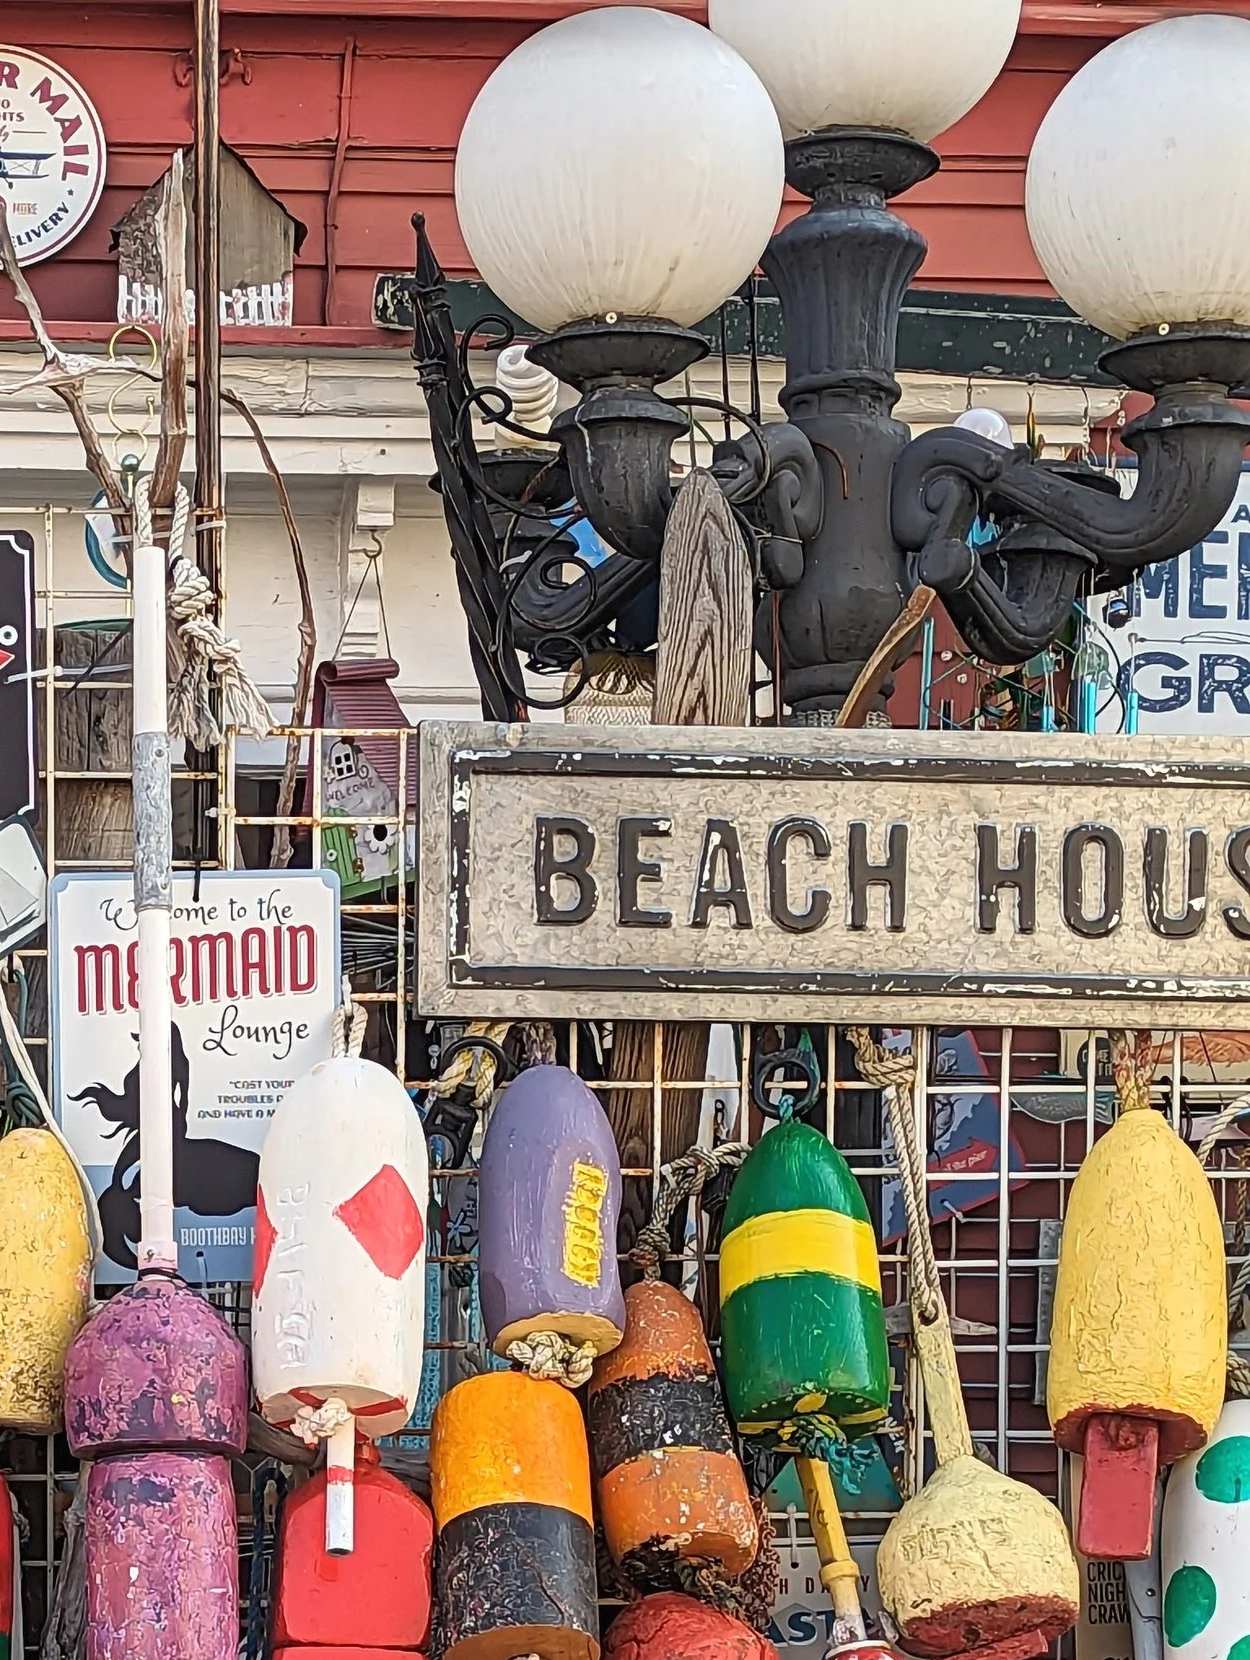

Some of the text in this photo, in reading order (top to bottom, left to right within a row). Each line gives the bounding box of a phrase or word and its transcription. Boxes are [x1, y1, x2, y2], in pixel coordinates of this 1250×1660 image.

[30, 77, 89, 181] MAIL
[1126, 531, 1250, 620] ME
[325, 778, 375, 802] WELCOME
[533, 815, 910, 935] BEACH
[229, 897, 247, 919] to
[257, 888, 294, 924] the
[202, 1004, 310, 1060] Lounge
[197, 1109, 221, 1119] AND
[224, 1109, 252, 1119] HAVE
[217, 1095, 274, 1104] TROUBLES
[180, 1226, 247, 1246] BOOTHBAY
